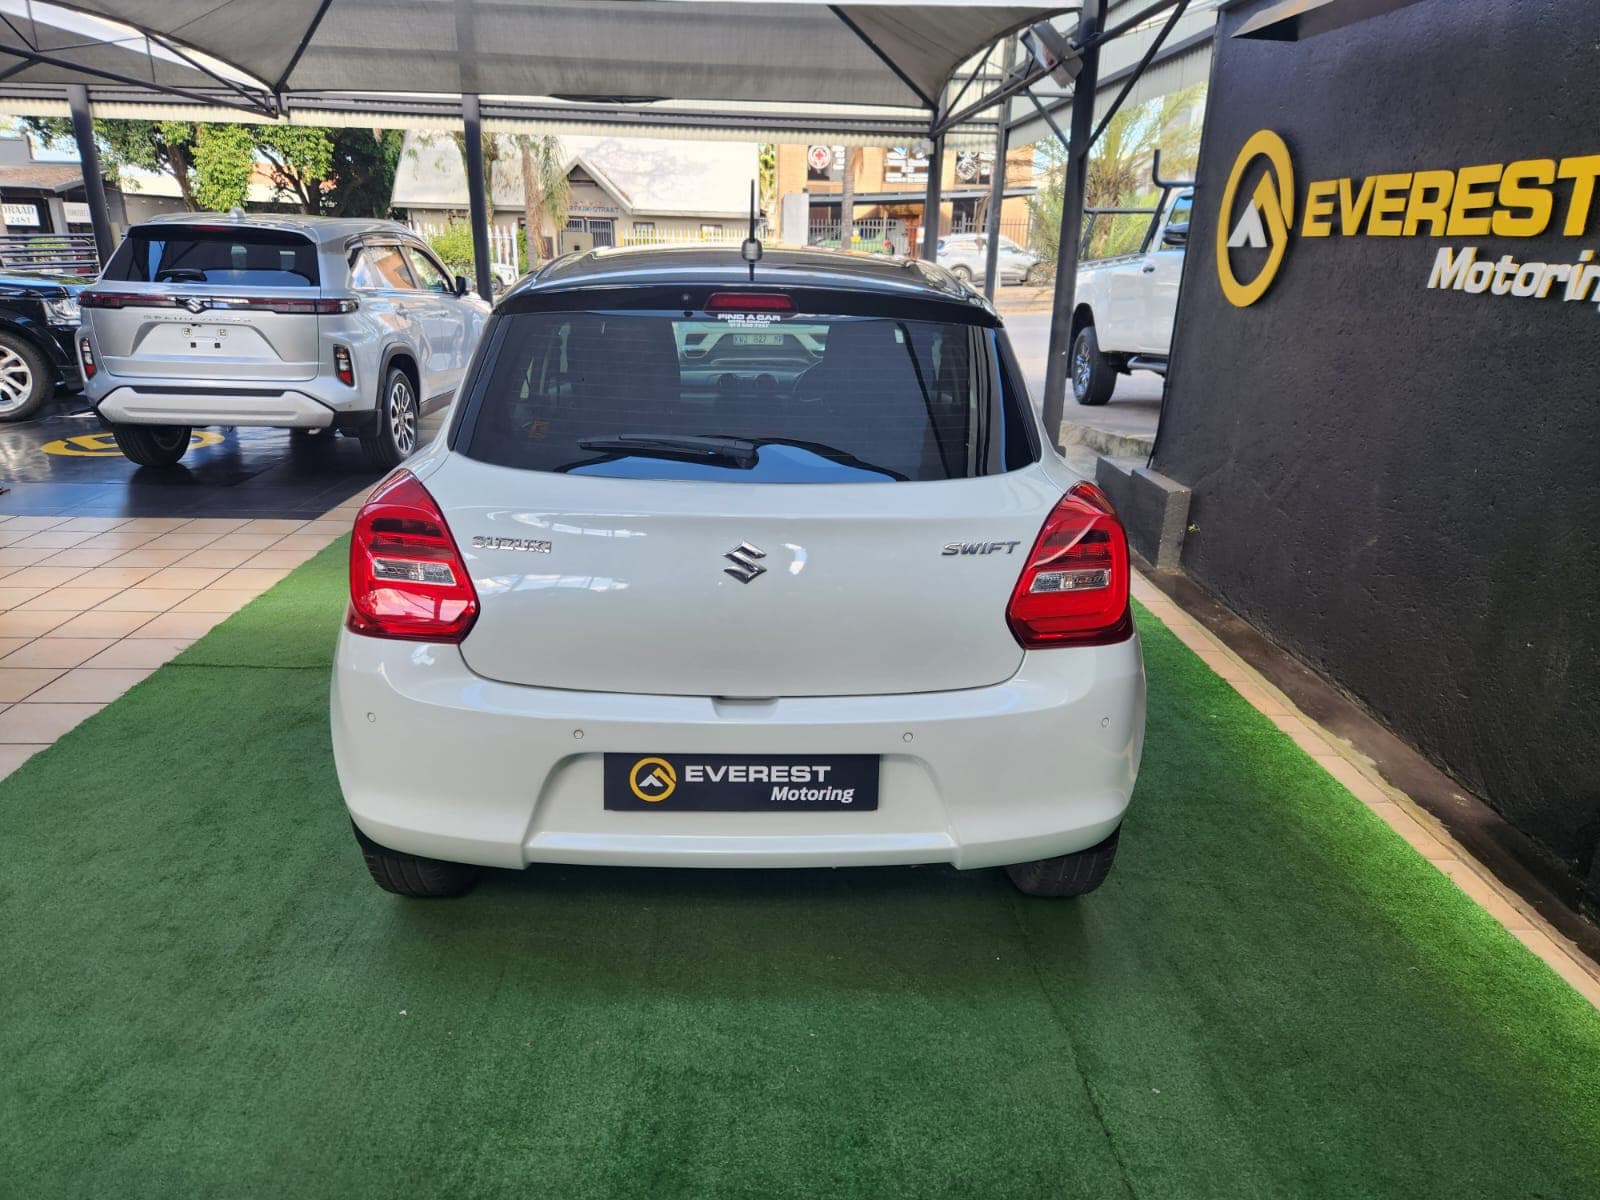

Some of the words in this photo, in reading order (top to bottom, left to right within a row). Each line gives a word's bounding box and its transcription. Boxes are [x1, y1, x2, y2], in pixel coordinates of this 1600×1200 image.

[1302, 154, 1600, 238] EVEREST
[1427, 246, 1600, 306] Motorin
[472, 536, 552, 553] SUZUKI
[941, 540, 1021, 556] SWIFT
[684, 765, 831, 783] EVEREST
[770, 786, 855, 803] Motoring
